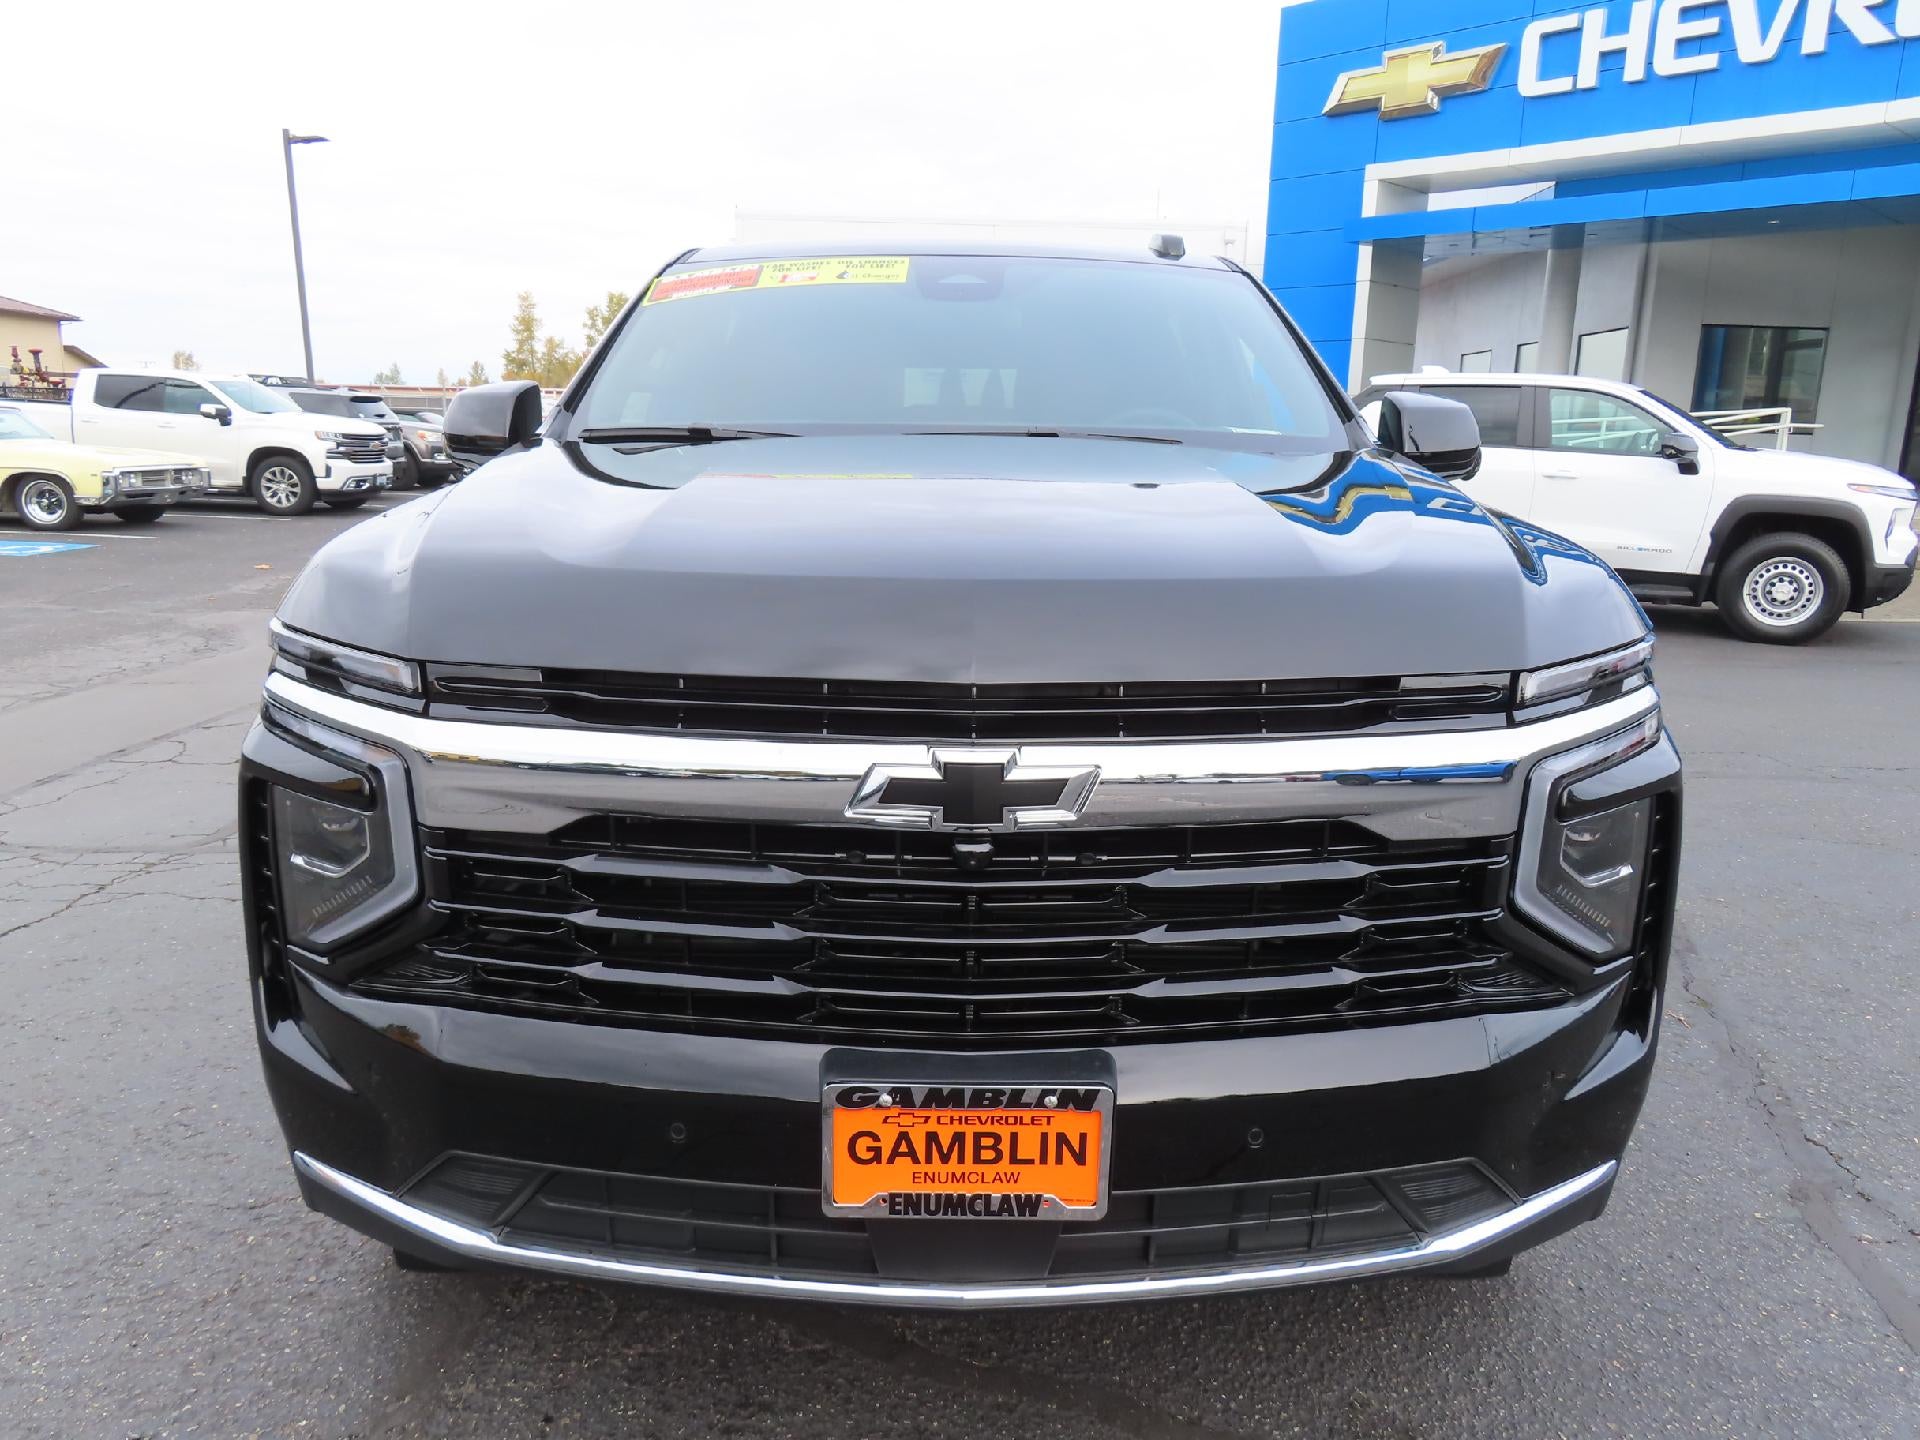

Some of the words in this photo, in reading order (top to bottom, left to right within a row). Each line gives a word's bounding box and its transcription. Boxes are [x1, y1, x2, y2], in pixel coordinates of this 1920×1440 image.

[1517, 0, 1920, 97] CHEVR
[835, 1086, 1100, 1111] GAMBLIN
[936, 1115, 1055, 1126] CHEVROLET
[847, 1131, 1088, 1166] GAMBLIN
[912, 1171, 1021, 1184] ENUMCLAW
[888, 1193, 1044, 1217] ENUMCLAW
